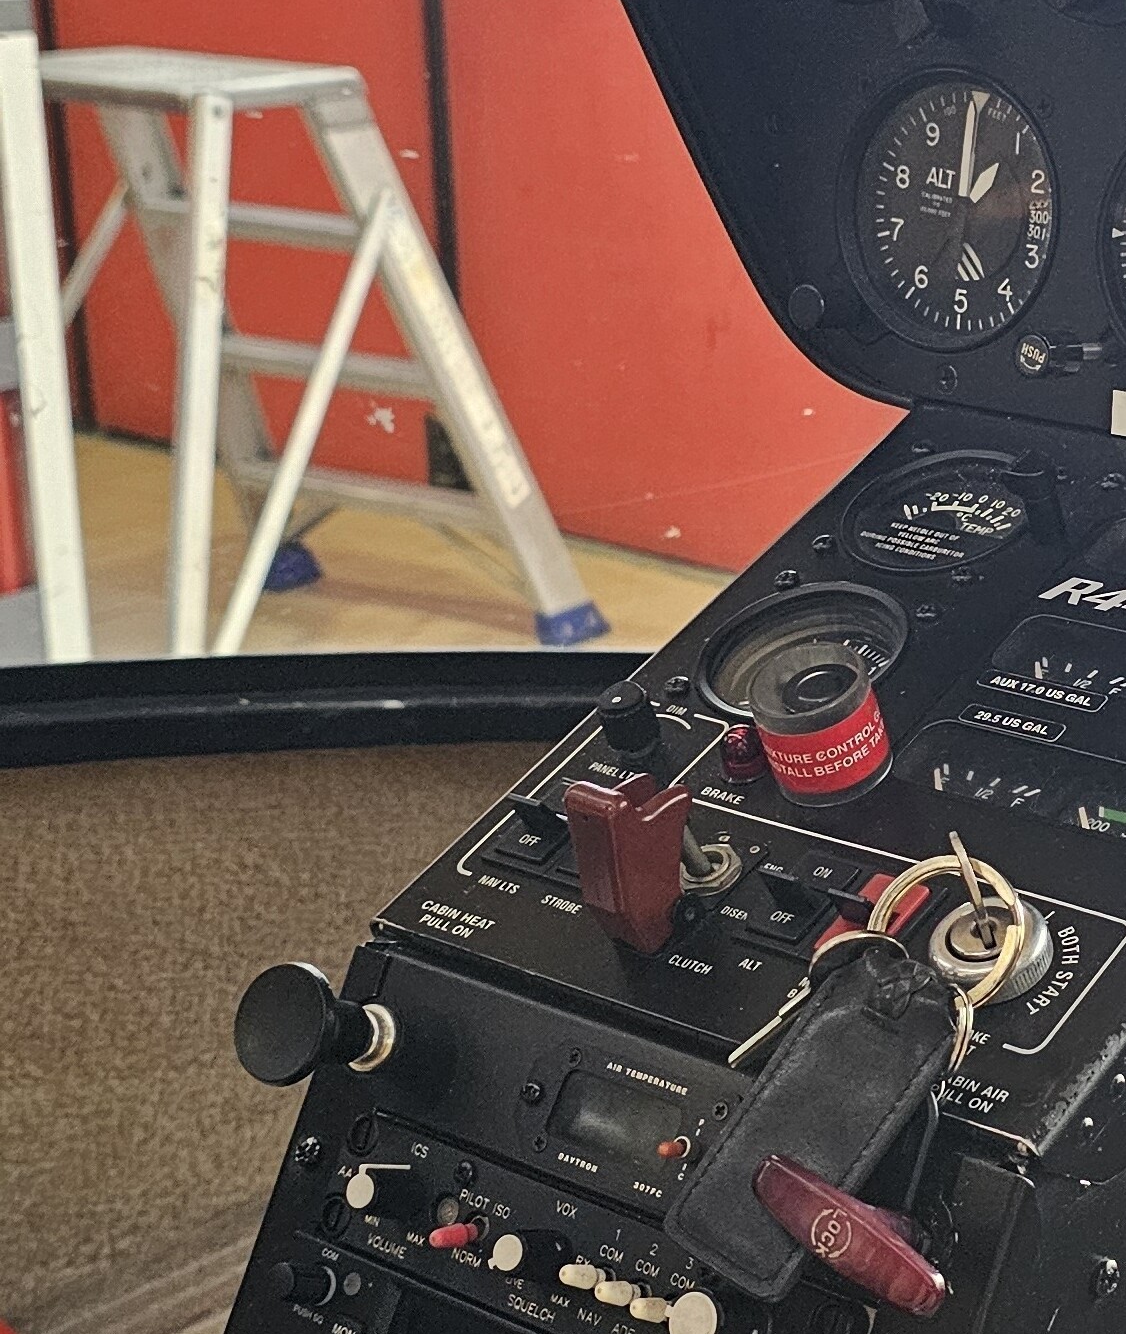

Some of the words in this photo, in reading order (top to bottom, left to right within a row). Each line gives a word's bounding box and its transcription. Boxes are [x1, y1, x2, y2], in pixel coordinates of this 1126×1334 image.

[926, 167, 956, 189] ALT
[1021, 342, 1047, 363] PUSH
[959, 521, 995, 536] TEMP
[990, 673, 1019, 688] AUX
[1020, 681, 1046, 696] 17.0
[1045, 688, 1065, 700] US
[1063, 693, 1092, 708] GAL
[666, 704, 688, 716] DIM
[973, 709, 1002, 724] 29.5
[1001, 716, 1021, 728] US
[1021, 721, 1049, 736] GAL
[815, 722, 875, 761] CONTROL
[587, 761, 620, 777] PANEL
[813, 744, 871, 777] BEFORE
[700, 786, 745, 805] BRAKE
[518, 833, 542, 847] OFF
[812, 866, 833, 879] ON
[477, 874, 501, 889] NAV
[499, 881, 521, 895] LTS
[421, 899, 463, 919] CABIN
[459, 911, 496, 931] HEAT
[540, 894, 583, 915] STROBE
[418, 913, 454, 932] PULL
[451, 923, 475, 939] ON
[769, 910, 795, 924] OFF
[1057, 925, 1080, 965] BOTH
[668, 954, 714, 976] CLUTCH
[737, 957, 763, 972] ALT
[1025, 970, 1074, 1016] START
[625, 1067, 688, 1096] TEMPERATURE
[980, 1085, 1010, 1103] AIR
[967, 1097, 994, 1114] ON
[410, 1142, 430, 1159] ICS
[557, 1152, 599, 1174] DAVTRON
[459, 1188, 490, 1212] PILOT
[491, 1201, 512, 1220] ISO
[555, 1199, 579, 1219] VOX
[815, 1208, 848, 1258] LOCK
[366, 1233, 408, 1260] VOLUME
[599, 1244, 625, 1264] COM
[451, 1247, 482, 1269] NORM
[635, 1258, 660, 1278] COM
[507, 1293, 557, 1324] SQUELCH
[576, 1307, 602, 1327] NAV
